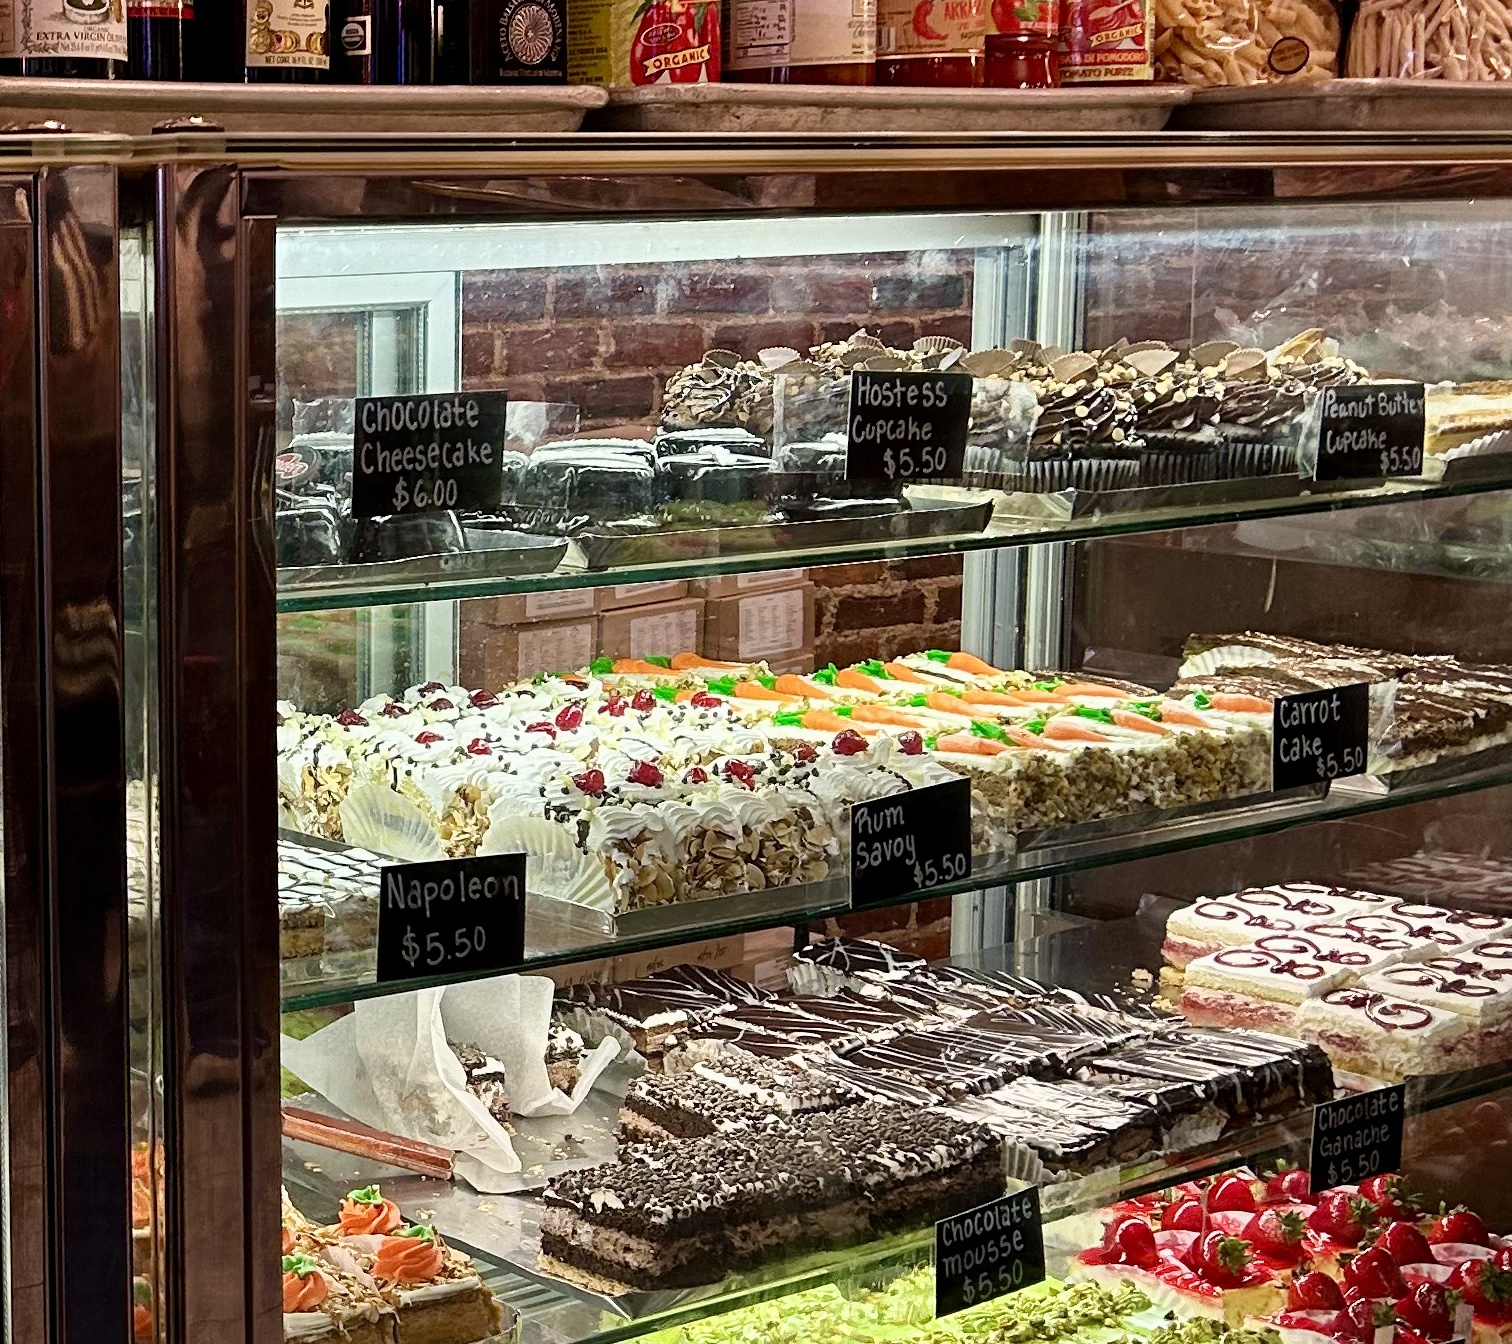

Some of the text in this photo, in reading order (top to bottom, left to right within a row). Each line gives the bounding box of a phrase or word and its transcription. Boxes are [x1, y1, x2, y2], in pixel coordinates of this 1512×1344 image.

[36, 32, 106, 42] EXTRA VIRGIN
[1096, 28, 1139, 41] ORGANIC
[653, 51, 705, 69] ORGANIC
[858, 375, 948, 408] Hostess
[1324, 389, 1424, 418] Peanut Butter
[362, 398, 480, 434] Chocolate
[852, 415, 932, 444] Cupcake
[360, 438, 494, 474] Cheesecake
[1326, 428, 1387, 454] Cupcake
[883, 446, 947, 479] $5.50
[1380, 445, 1421, 475] $5.50
[392, 476, 458, 511] $6.00
[1280, 693, 1340, 728] Carrot
[1316, 746, 1363, 778] $5.50
[854, 805, 905, 834] Rum
[913, 853, 966, 889] $5.50
[387, 870, 519, 918] Napoleon
[402, 924, 486, 968] $5.50
[1319, 1092, 1399, 1131] Chocolate
[1320, 1123, 1390, 1157] Ganache
[943, 1197, 1033, 1247] Chocolate
[942, 1229, 1024, 1278] mousse
[962, 1258, 1023, 1304] $5.50
